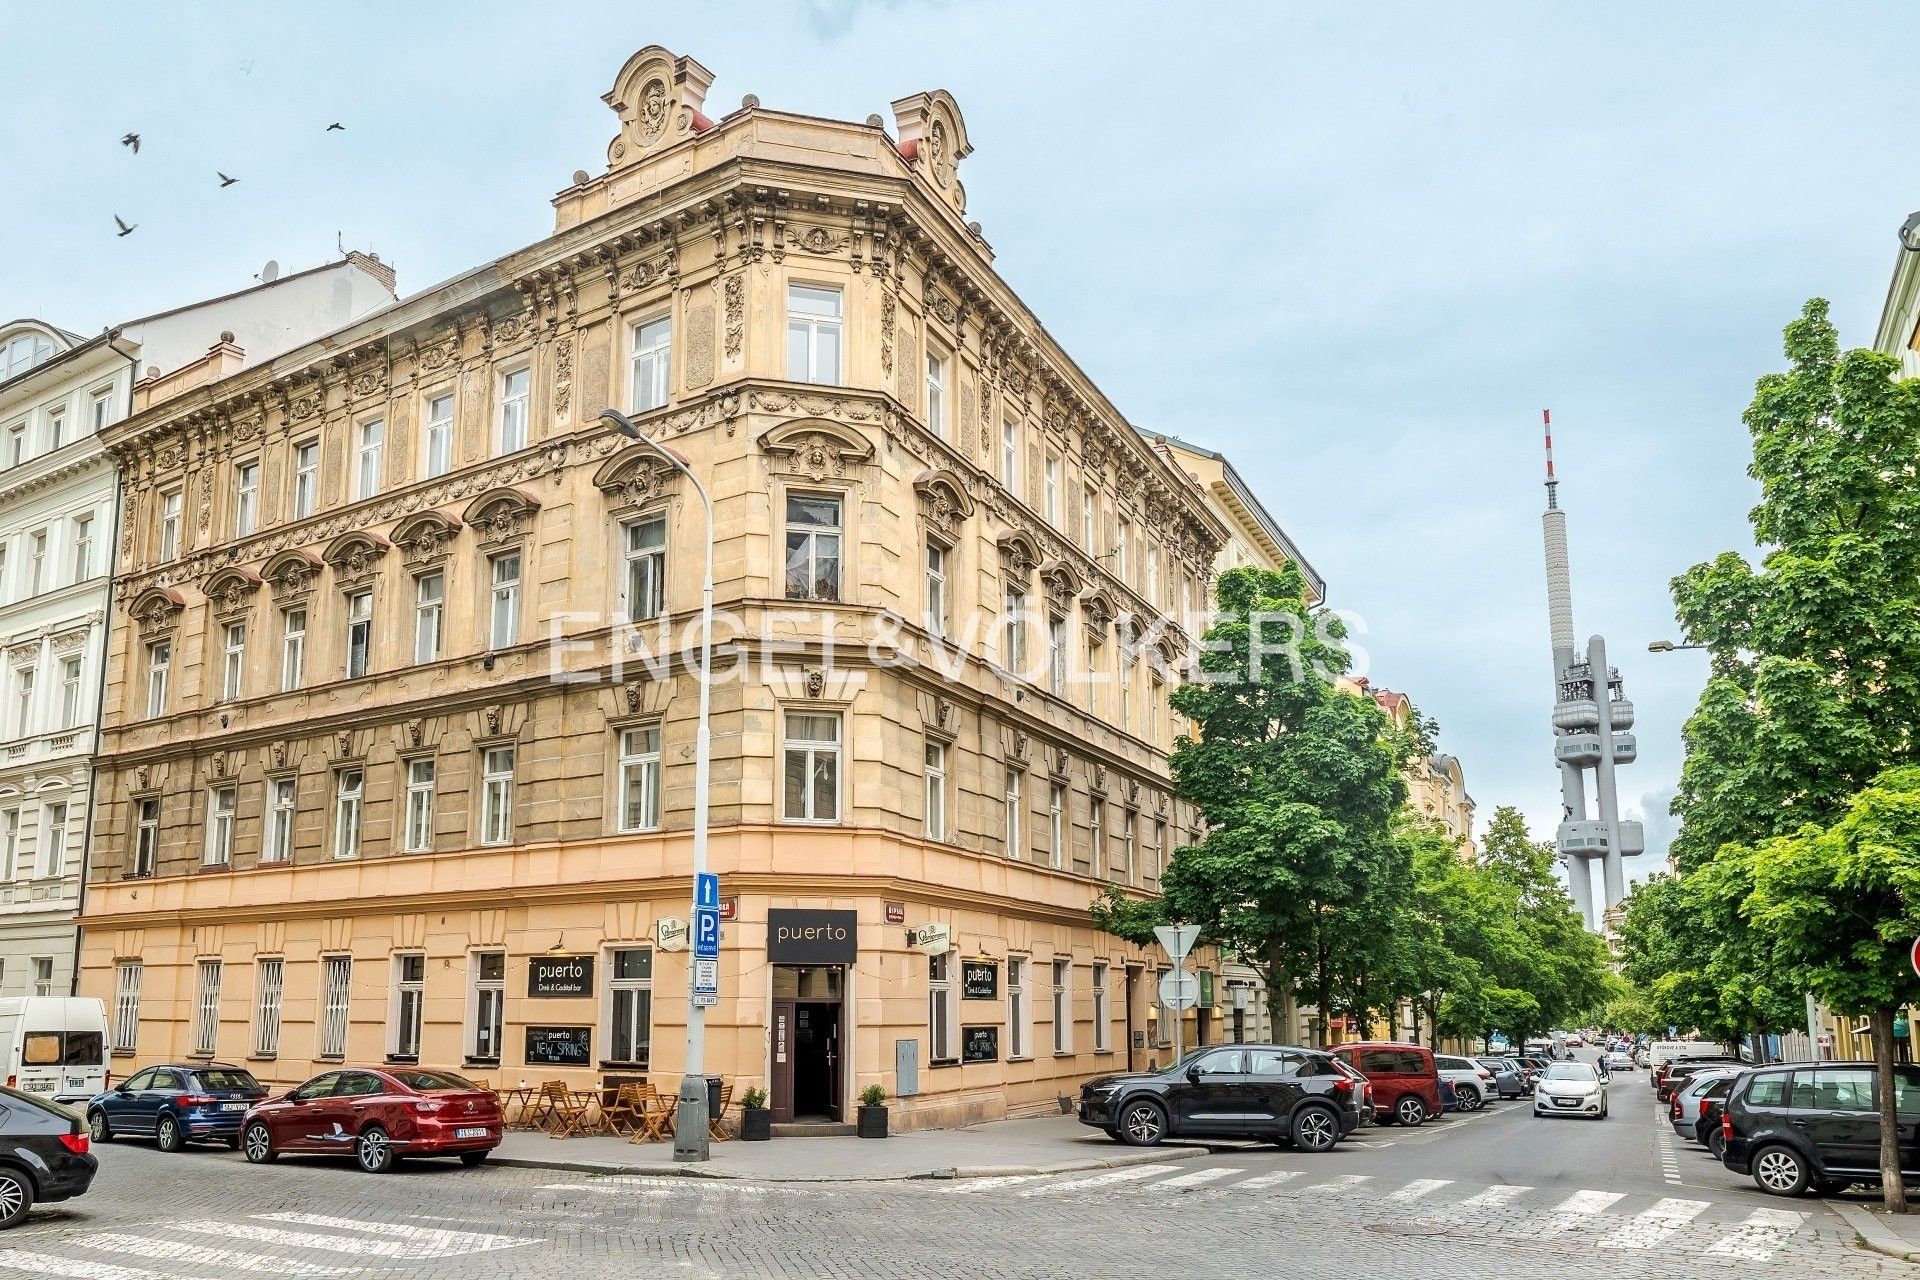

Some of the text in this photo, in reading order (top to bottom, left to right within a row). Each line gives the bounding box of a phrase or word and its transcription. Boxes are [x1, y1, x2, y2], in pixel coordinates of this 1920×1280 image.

[701, 914, 715, 942] P
[778, 923, 846, 943] puerto
[538, 961, 583, 982] puerto
[967, 967, 992, 985] puerto
[573, 983, 582, 991] bar
[548, 1030, 570, 1041] puerto
[974, 1030, 988, 1039] puerto
[536, 1041, 582, 1057] NEW SPRING
